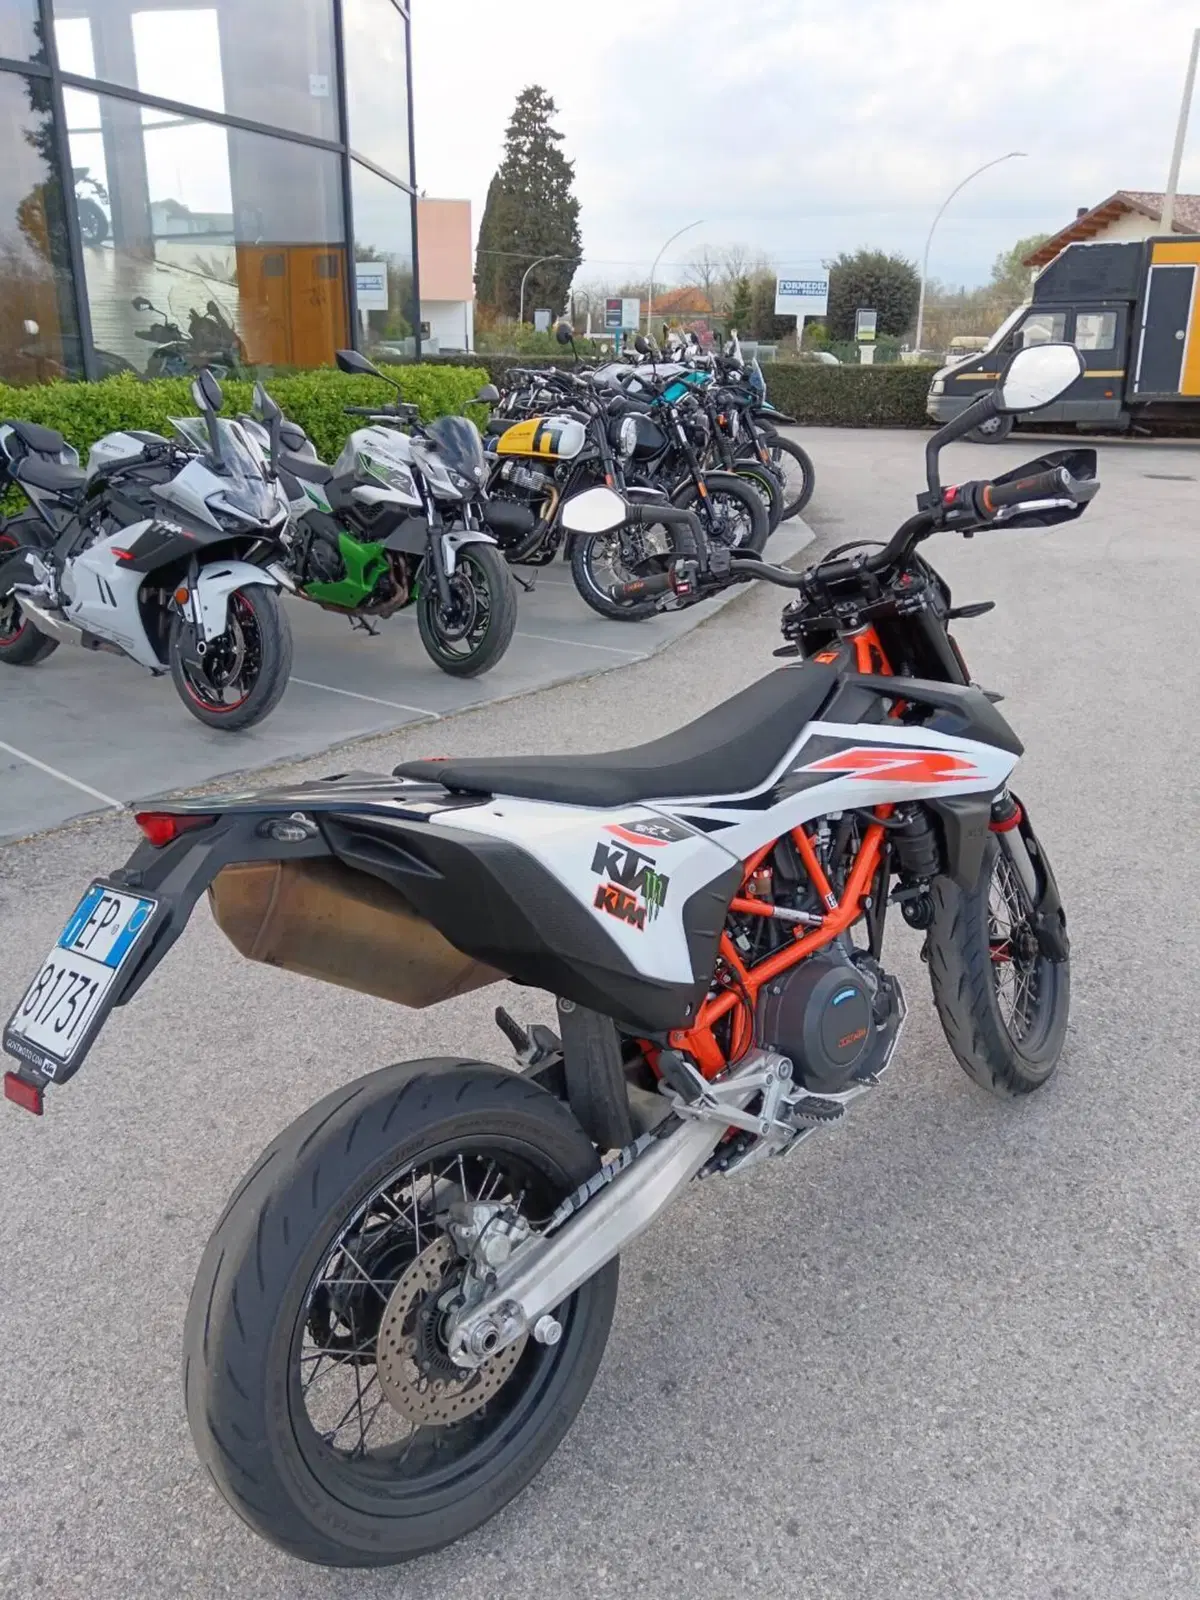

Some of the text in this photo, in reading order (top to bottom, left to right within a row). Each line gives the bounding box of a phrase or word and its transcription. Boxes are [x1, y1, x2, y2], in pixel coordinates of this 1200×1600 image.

[780, 282, 827, 290] FORMEDIL
[591, 839, 670, 908] KTM
[74, 895, 121, 950] EP
[593, 882, 648, 933] KTM
[23, 963, 99, 1041] 81731
